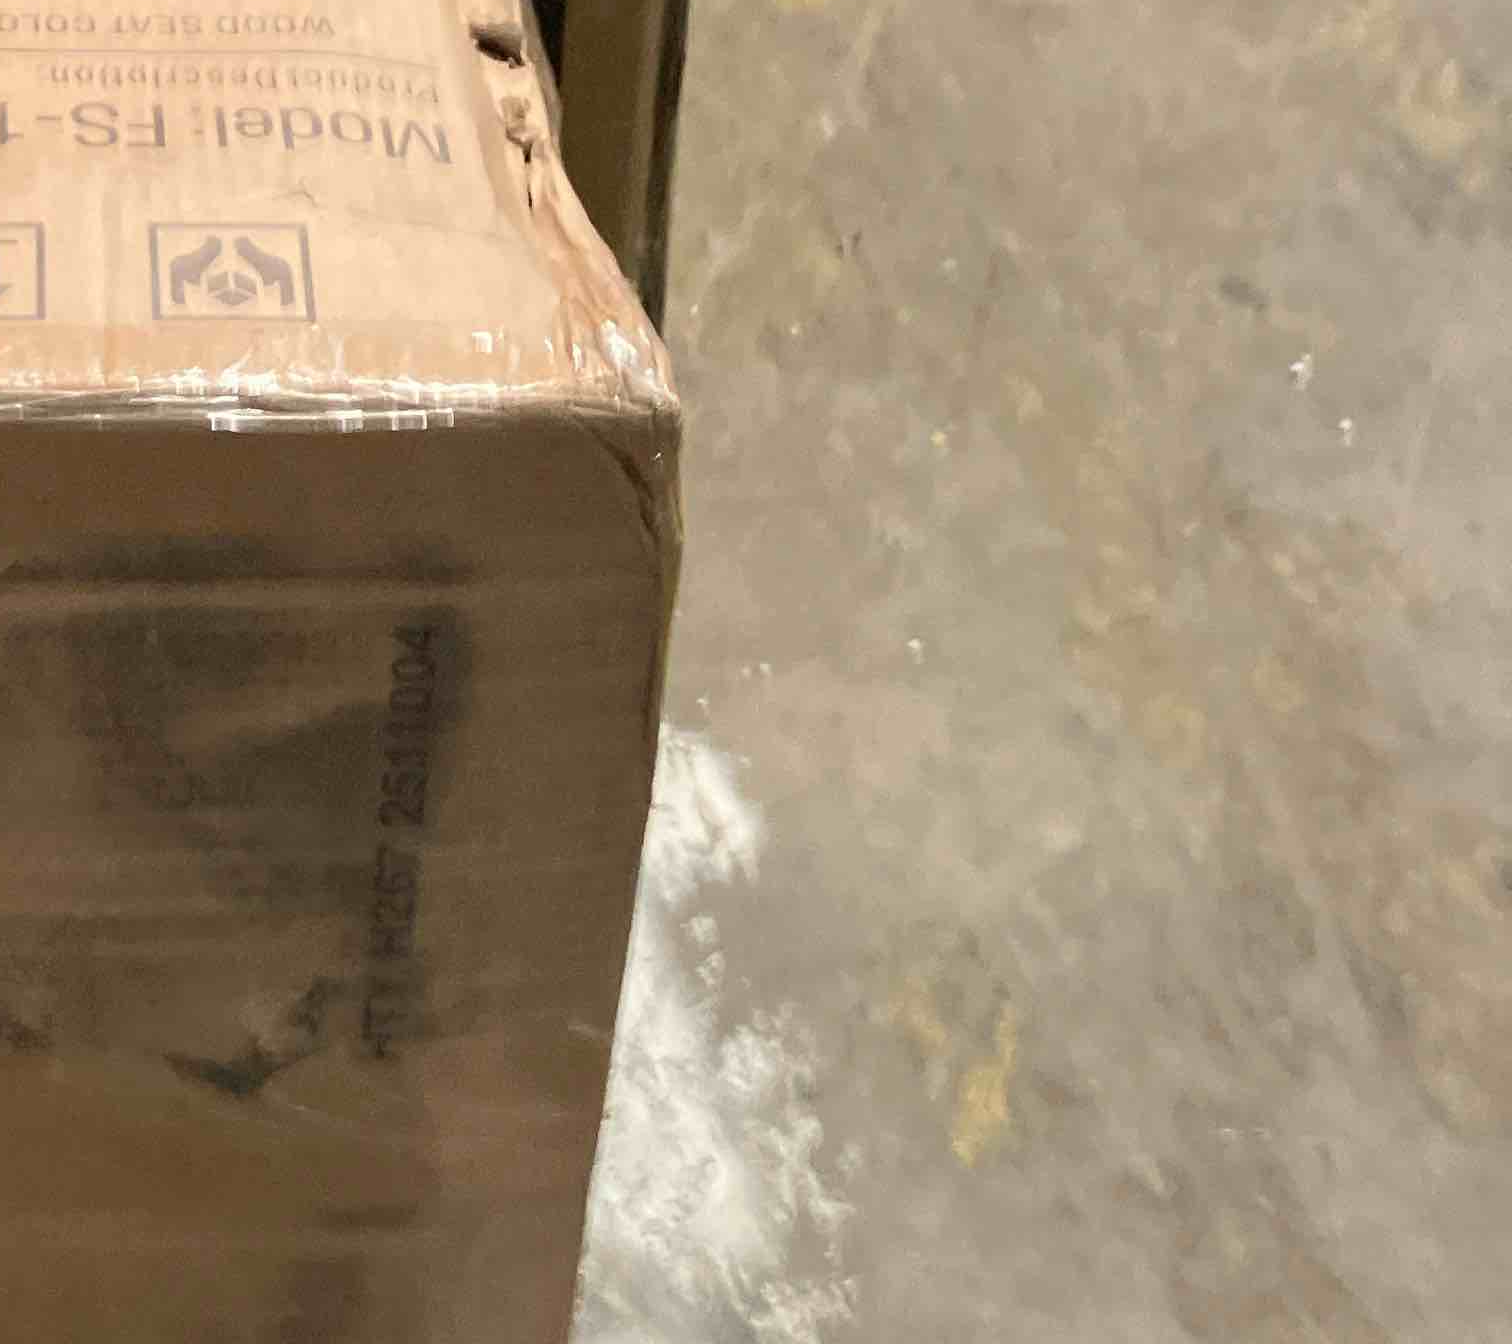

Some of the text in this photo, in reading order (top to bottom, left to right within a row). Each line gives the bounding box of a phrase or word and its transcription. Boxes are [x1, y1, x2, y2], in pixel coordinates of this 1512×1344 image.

[113, 13, 203, 36] SEAT
[216, 13, 335, 39] WOOD
[287, 64, 441, 104] Product
[189, 103, 454, 164] Model:
